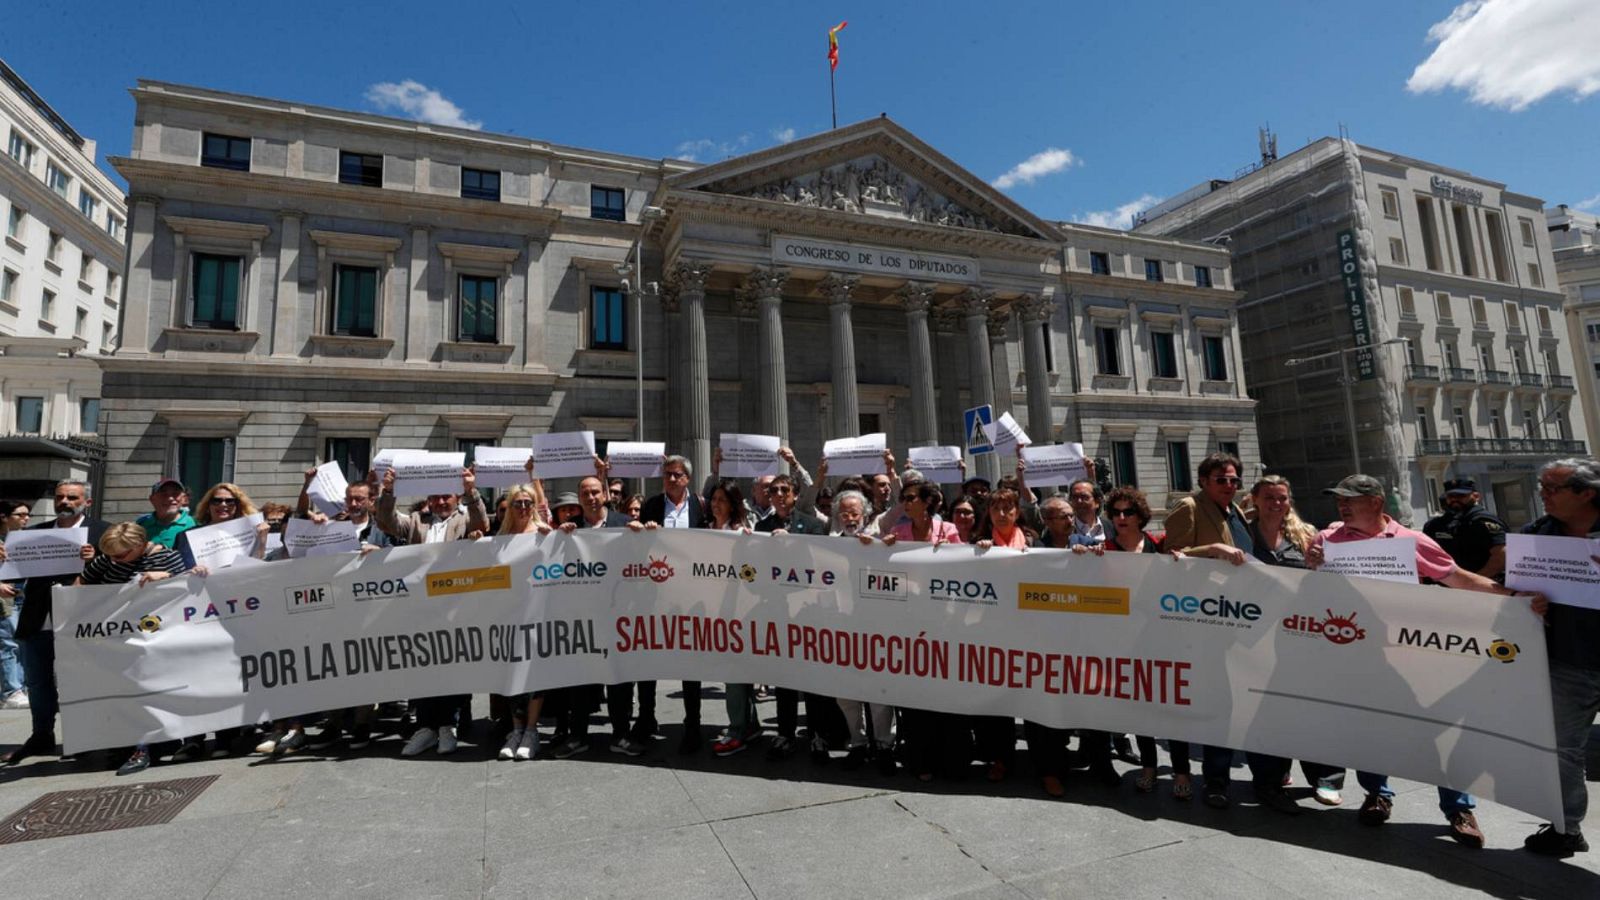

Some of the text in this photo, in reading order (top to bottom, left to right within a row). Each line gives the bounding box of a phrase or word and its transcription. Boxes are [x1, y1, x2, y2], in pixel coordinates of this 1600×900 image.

[785, 244, 968, 276] CONGRESO DE LOS DIPUTADOS
[1340, 234, 1367, 345] PROLISER
[692, 562, 738, 579] MAPA
[1515, 563, 1548, 571] CULTURAL,
[1549, 566, 1587, 575] SALVEMOS
[1547, 558, 1590, 567] DIVERSIDAD
[352, 578, 409, 597] PROA
[432, 575, 475, 589] PROFILM
[868, 574, 900, 592] PIAF
[1549, 574, 1600, 584] INDEPENDIENT
[293, 587, 325, 606] PIAF
[929, 578, 998, 600] PROA
[1024, 591, 1078, 605] PROFILM
[75, 620, 135, 639] MAPA
[1397, 627, 1481, 656] MAPA
[240, 615, 1192, 706] POR LA DIVERSIDAD CULTURAL, SALVEMOS LA PRODUCCIÓN INDEPENDIENTE
